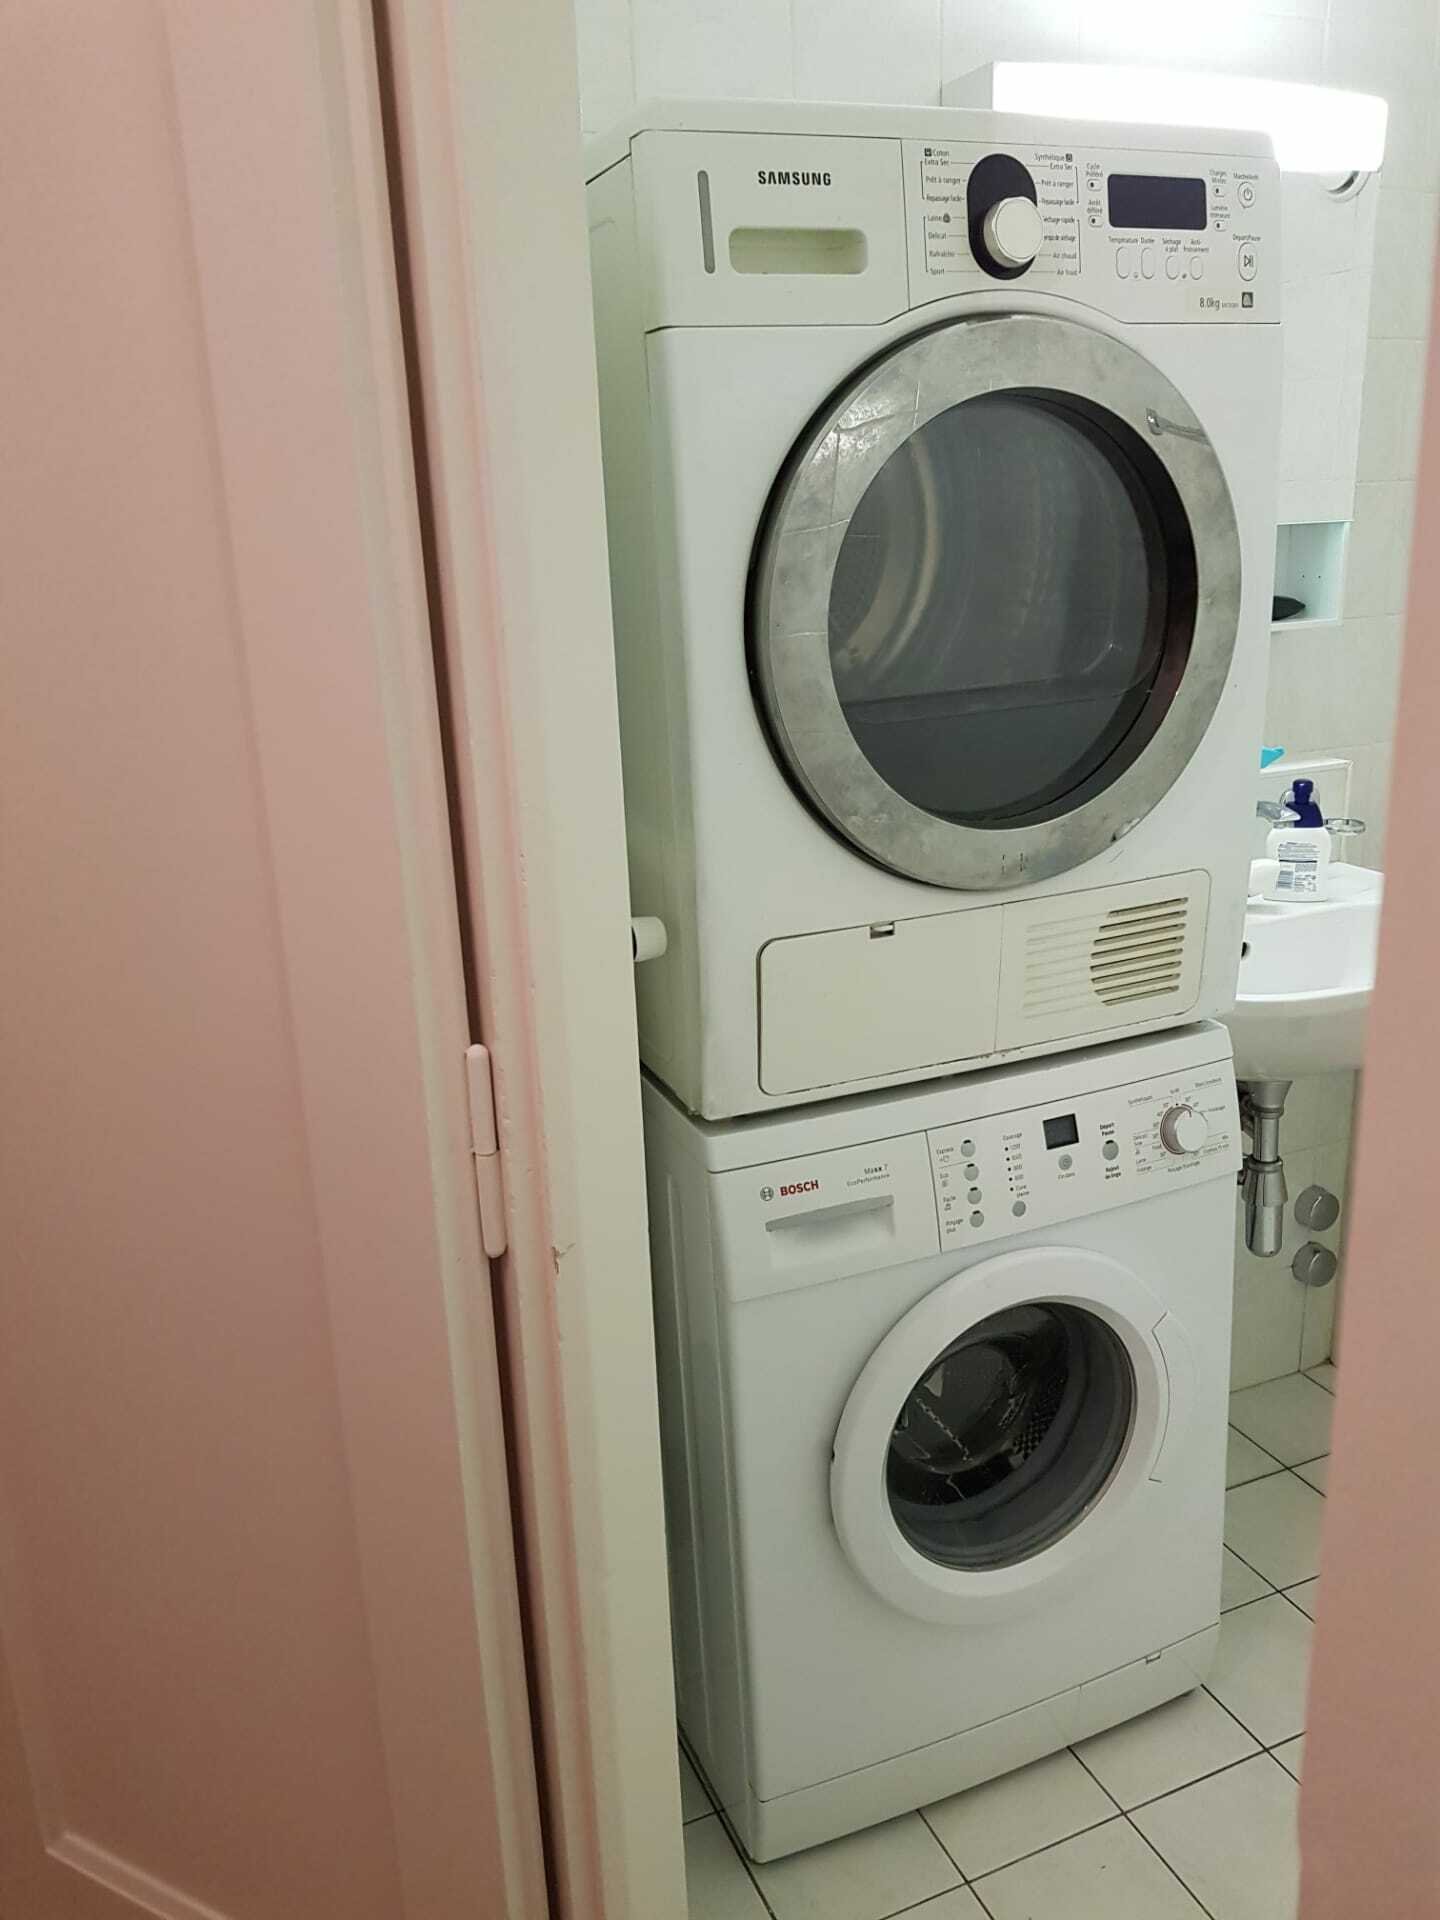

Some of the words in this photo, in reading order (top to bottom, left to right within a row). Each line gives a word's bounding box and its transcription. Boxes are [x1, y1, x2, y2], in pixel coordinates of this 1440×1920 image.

[758, 170, 831, 186] SAMSUNG
[1199, 297, 1220, 311] 8.0kg
[780, 1179, 819, 1197] BOSCH
